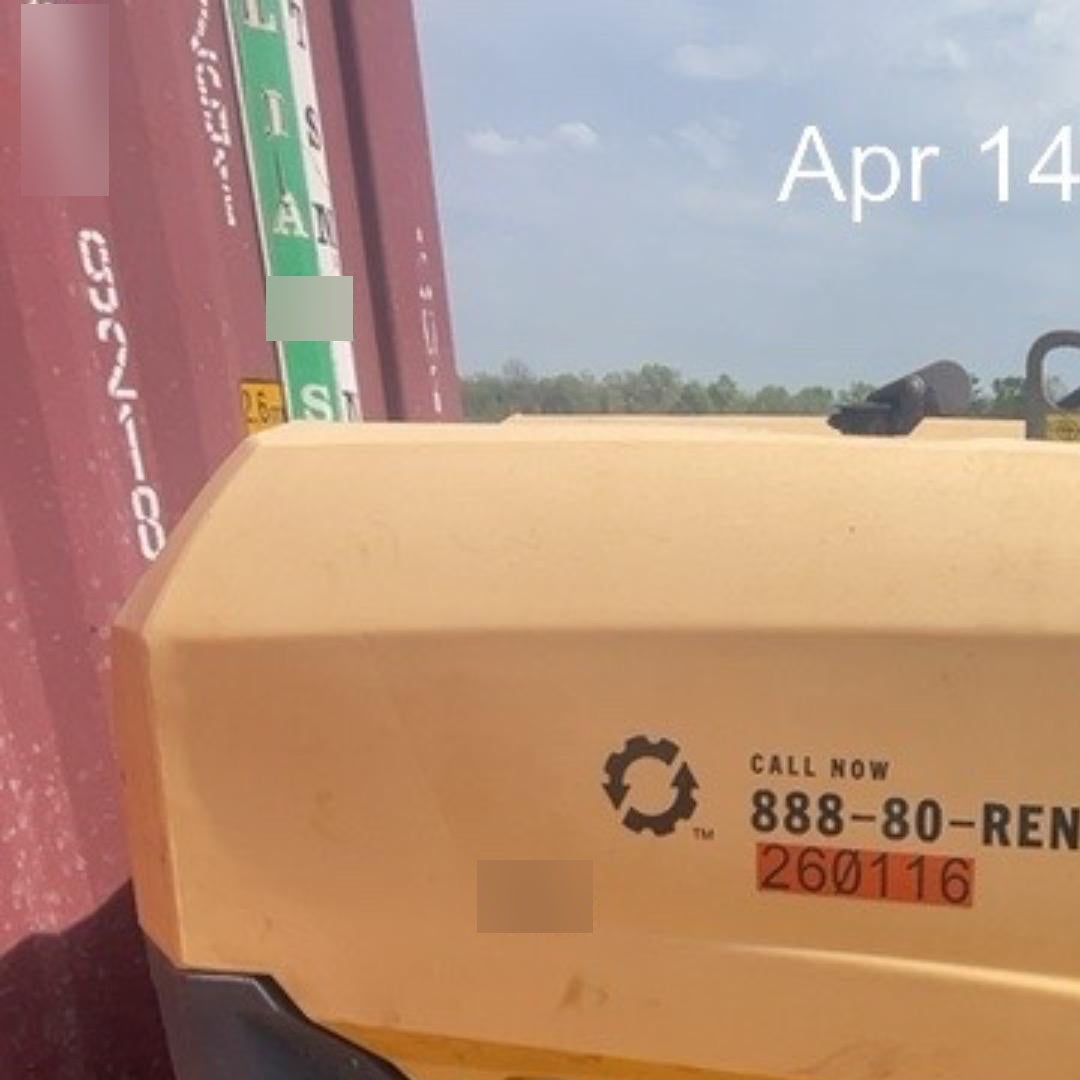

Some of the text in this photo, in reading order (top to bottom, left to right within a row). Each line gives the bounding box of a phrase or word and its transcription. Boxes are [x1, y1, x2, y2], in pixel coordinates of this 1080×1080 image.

[750, 753, 890, 781] CALL NOW
[759, 844, 973, 904] 260116
